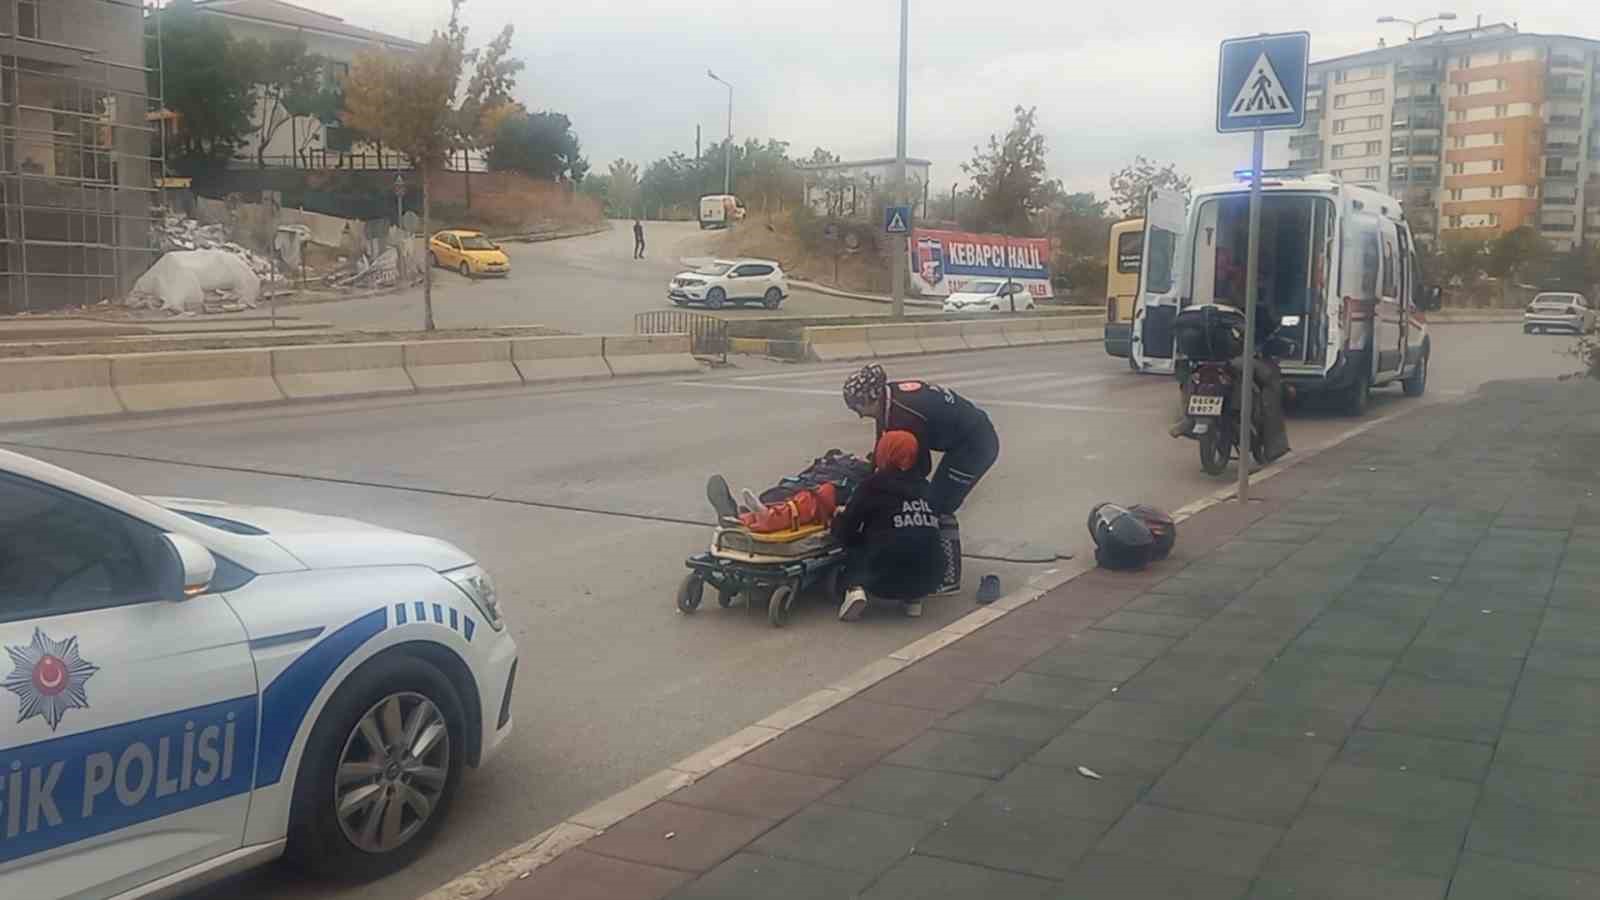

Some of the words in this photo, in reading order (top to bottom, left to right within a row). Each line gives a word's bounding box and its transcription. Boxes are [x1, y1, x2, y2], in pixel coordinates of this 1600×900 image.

[1008, 243, 1043, 270] HALİL
[902, 498, 932, 513] ACİL
[0, 760, 65, 837] İK
[82, 711, 236, 819] POLİSİ
